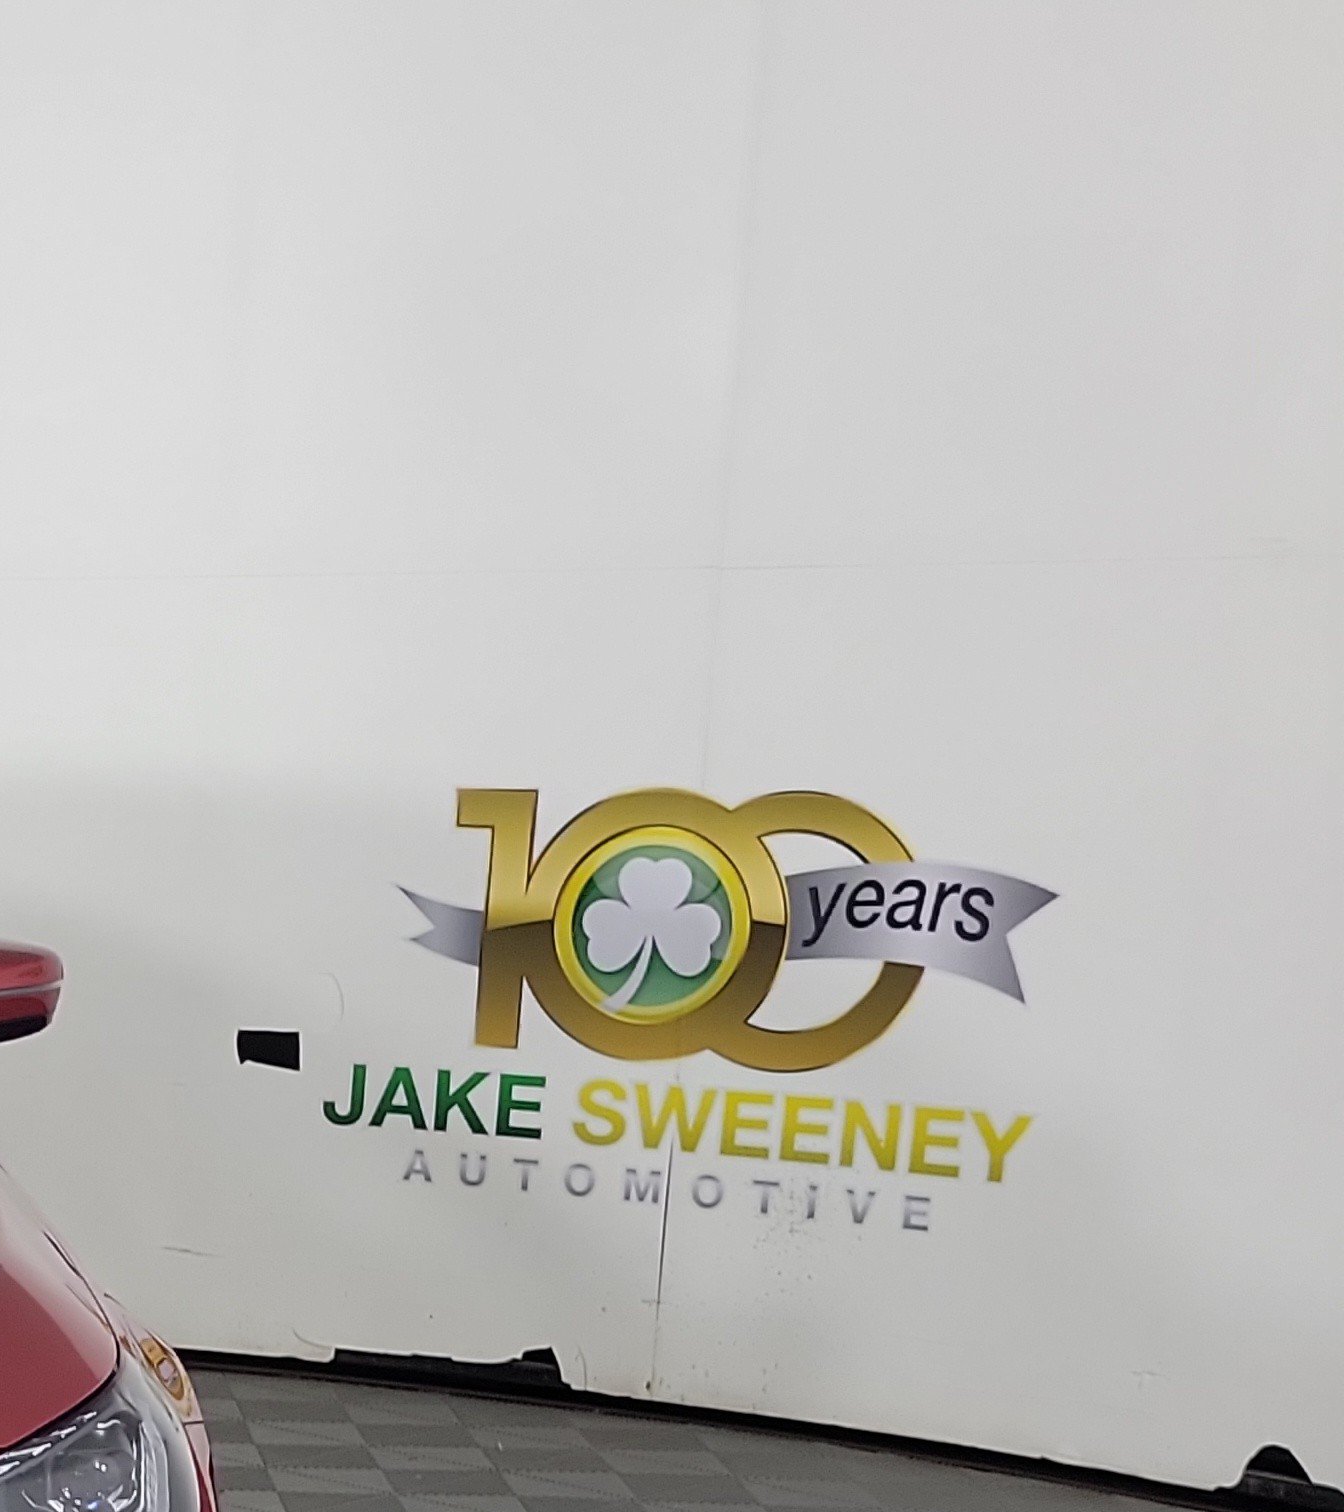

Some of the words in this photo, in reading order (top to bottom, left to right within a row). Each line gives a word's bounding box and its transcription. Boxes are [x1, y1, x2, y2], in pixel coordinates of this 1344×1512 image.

[457, 787, 924, 1073] 100
[801, 876, 995, 948] years
[322, 1063, 548, 1140] JAKE
[571, 1077, 1034, 1183] SWEENEY
[402, 1148, 933, 1233] AUTOMOTIVE
